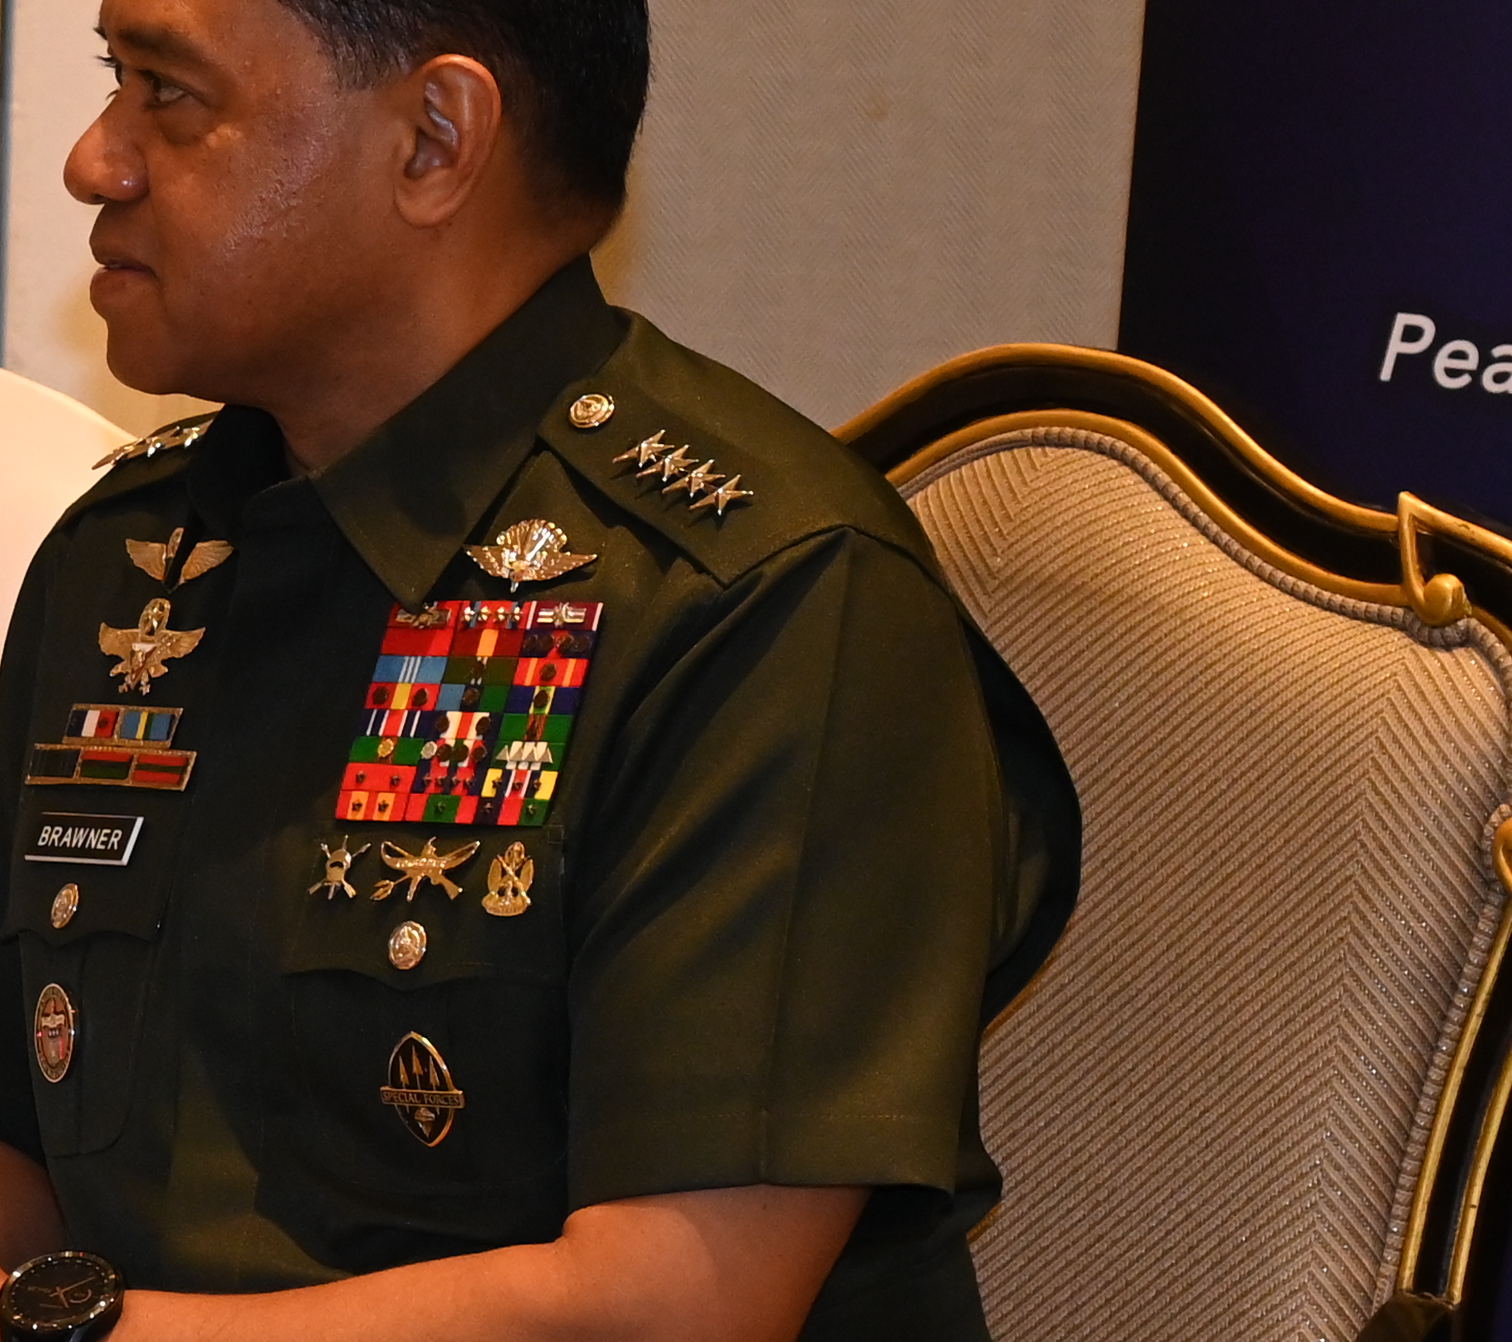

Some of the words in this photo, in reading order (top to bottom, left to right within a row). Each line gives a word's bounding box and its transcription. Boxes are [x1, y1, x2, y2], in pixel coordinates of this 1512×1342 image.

[37, 825, 123, 851] BRAWNER
[382, 1092, 421, 1104] SPECIAL
[423, 1093, 460, 1105] FORCES
